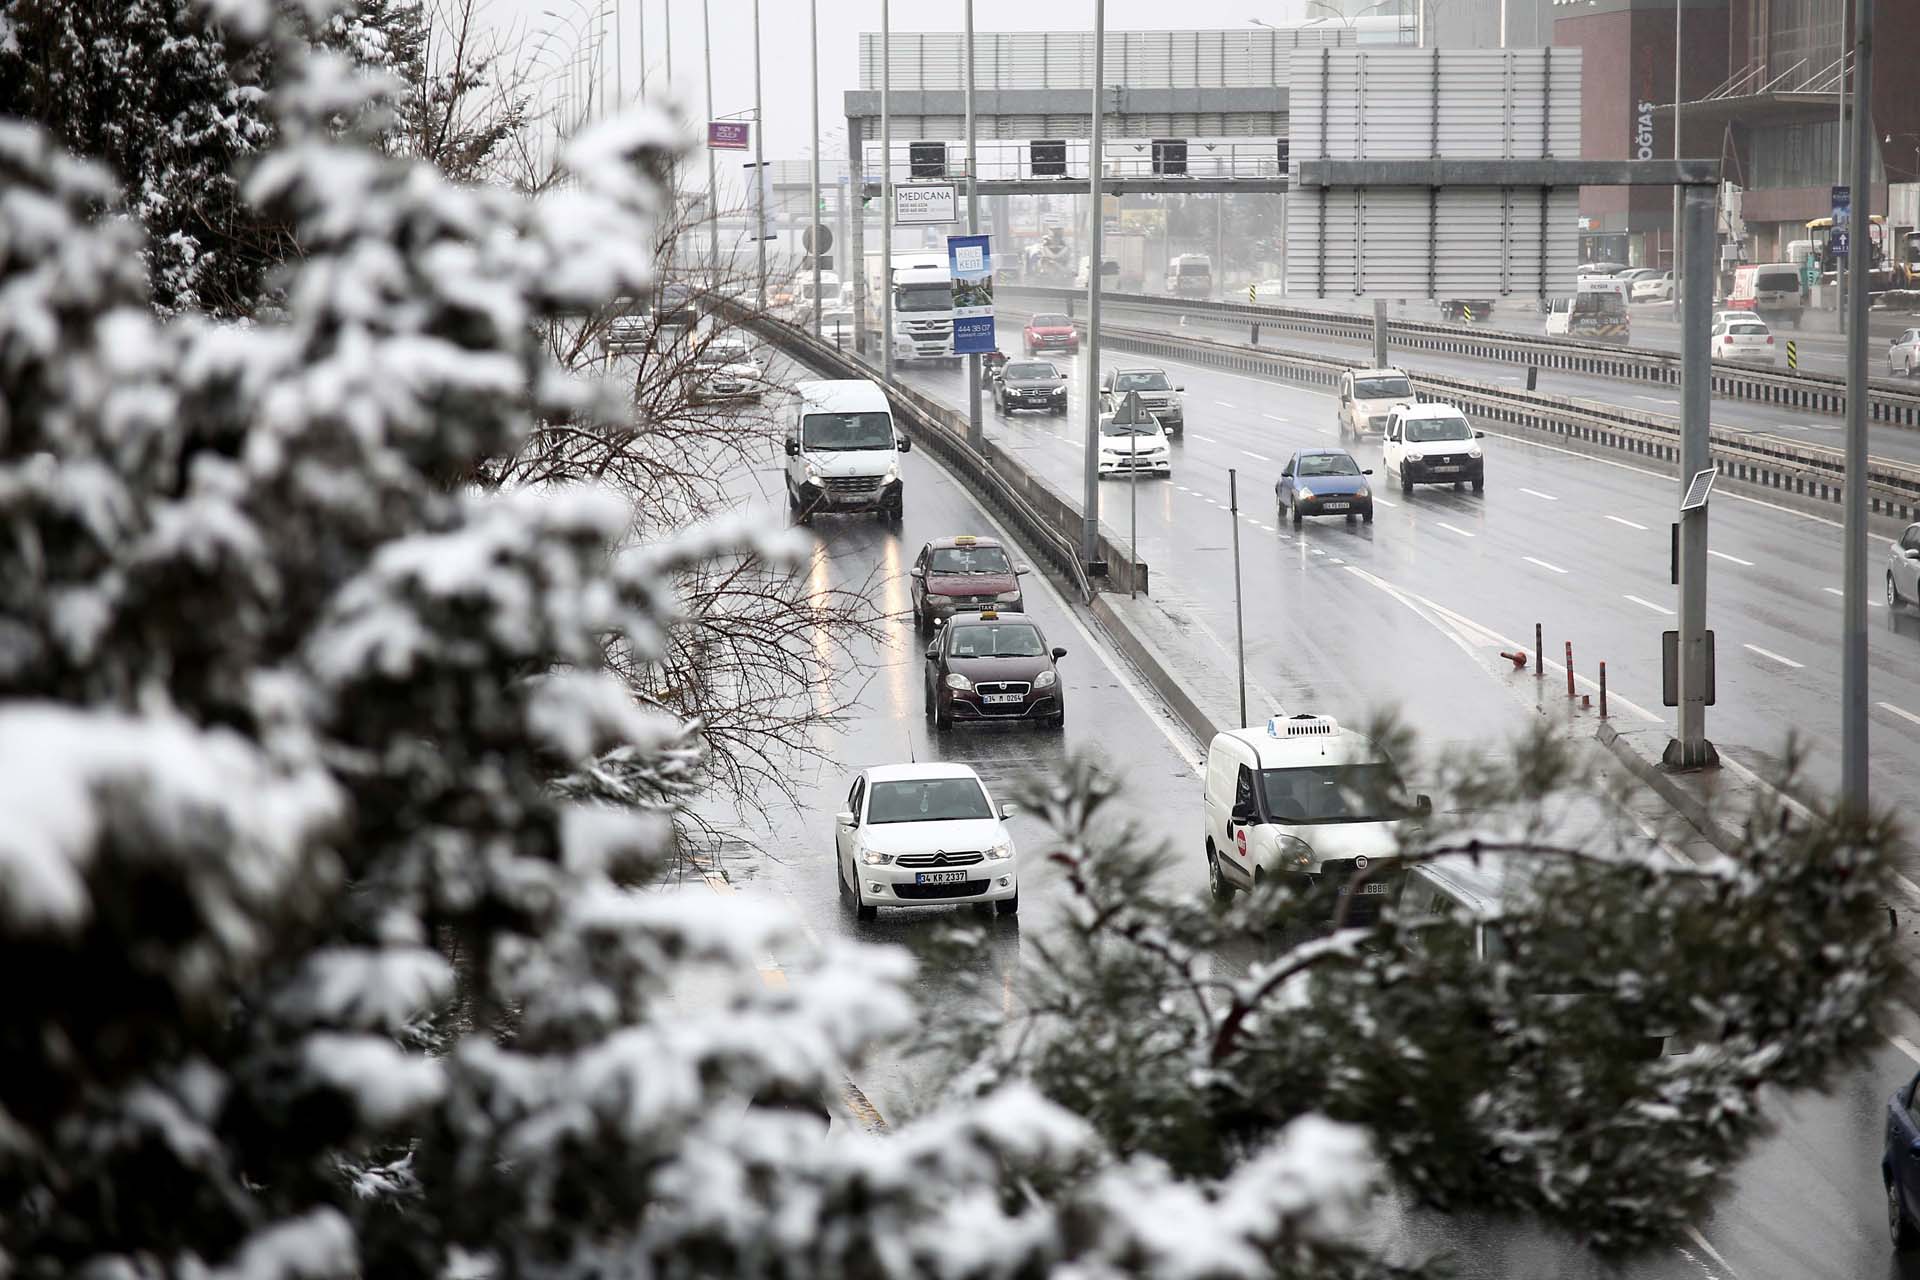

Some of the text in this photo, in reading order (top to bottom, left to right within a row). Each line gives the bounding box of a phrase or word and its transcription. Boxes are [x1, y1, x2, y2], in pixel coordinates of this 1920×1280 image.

[1635, 101, 1653, 160] OĞTAŞ
[899, 191, 951, 201] MEDICANA
[921, 872, 965, 883] 34 KR 2337
